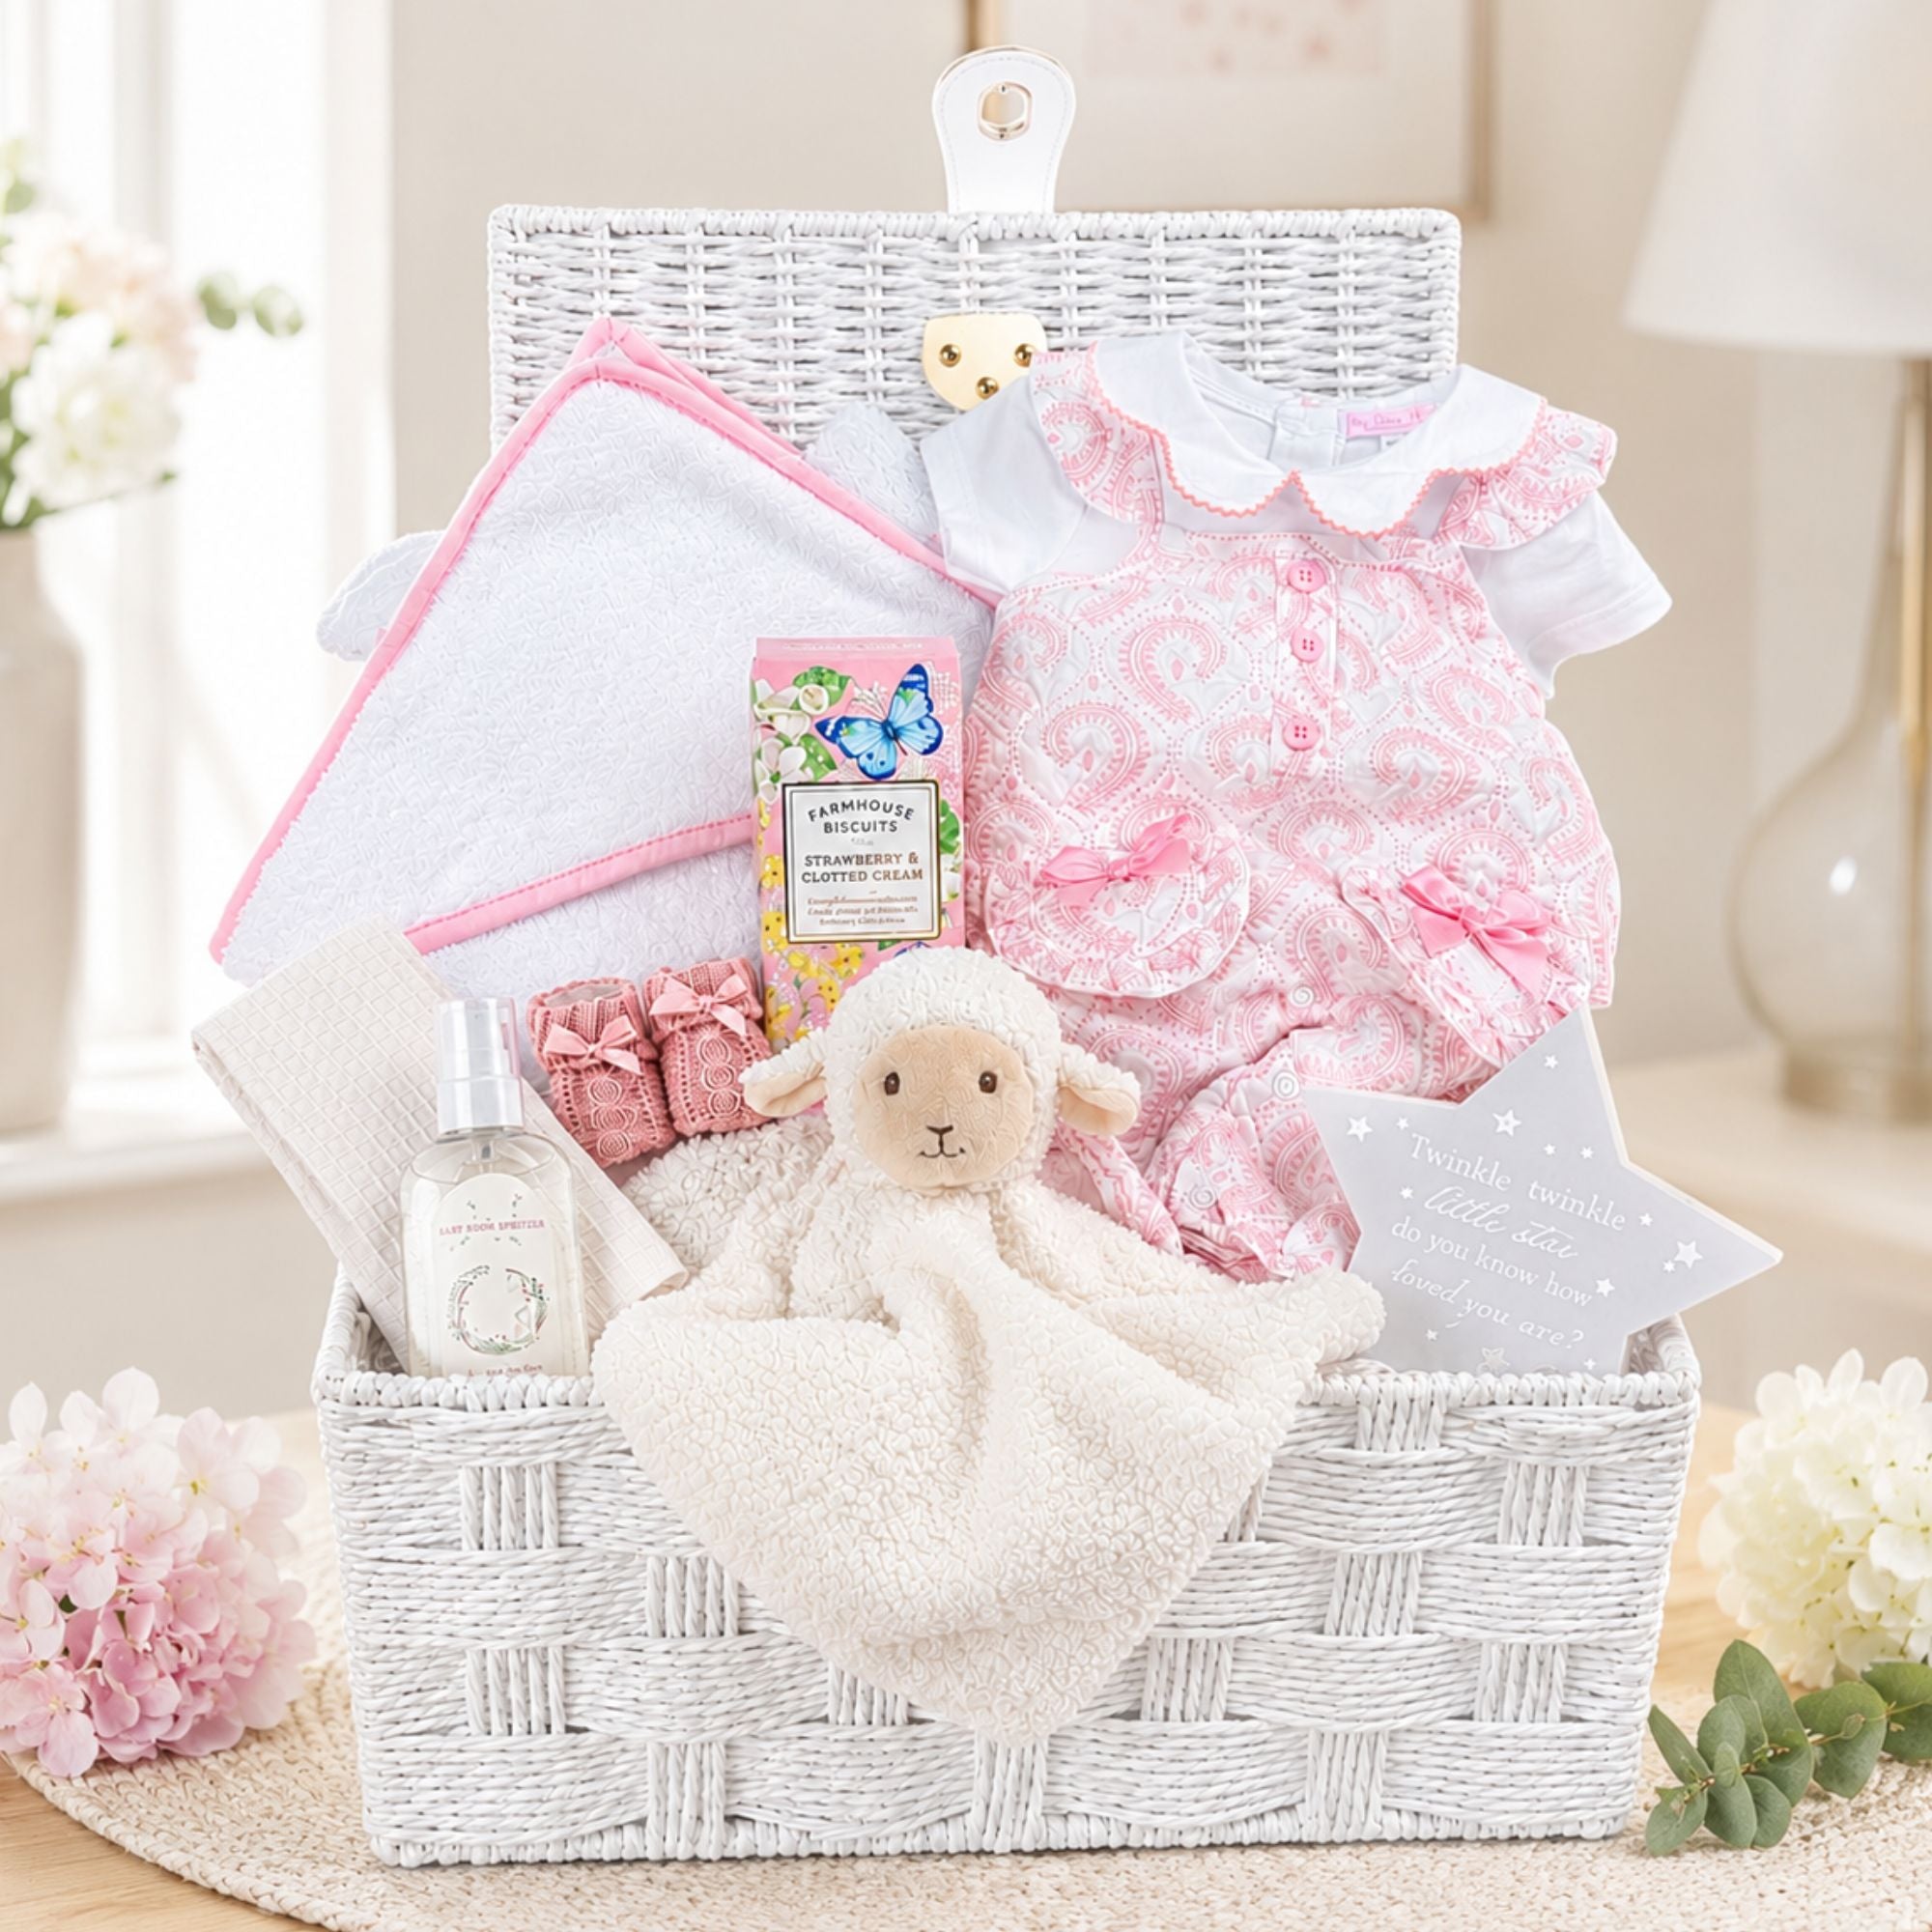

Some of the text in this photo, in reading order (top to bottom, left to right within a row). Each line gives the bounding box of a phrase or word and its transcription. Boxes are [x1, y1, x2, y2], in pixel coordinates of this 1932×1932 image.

[808, 799, 915, 822] FARMHOUSE
[824, 820, 898, 834] BISCUITS
[801, 868, 923, 884] CLOTTED CREAM
[805, 852, 919, 867] STRAWBERRY &
[1410, 1132, 1626, 1231] Twinkle twinkle
[1424, 1185, 1511, 1234] little
[1391, 1215, 1593, 1306] do you know how
[1391, 1259, 1584, 1350] loved you are?
